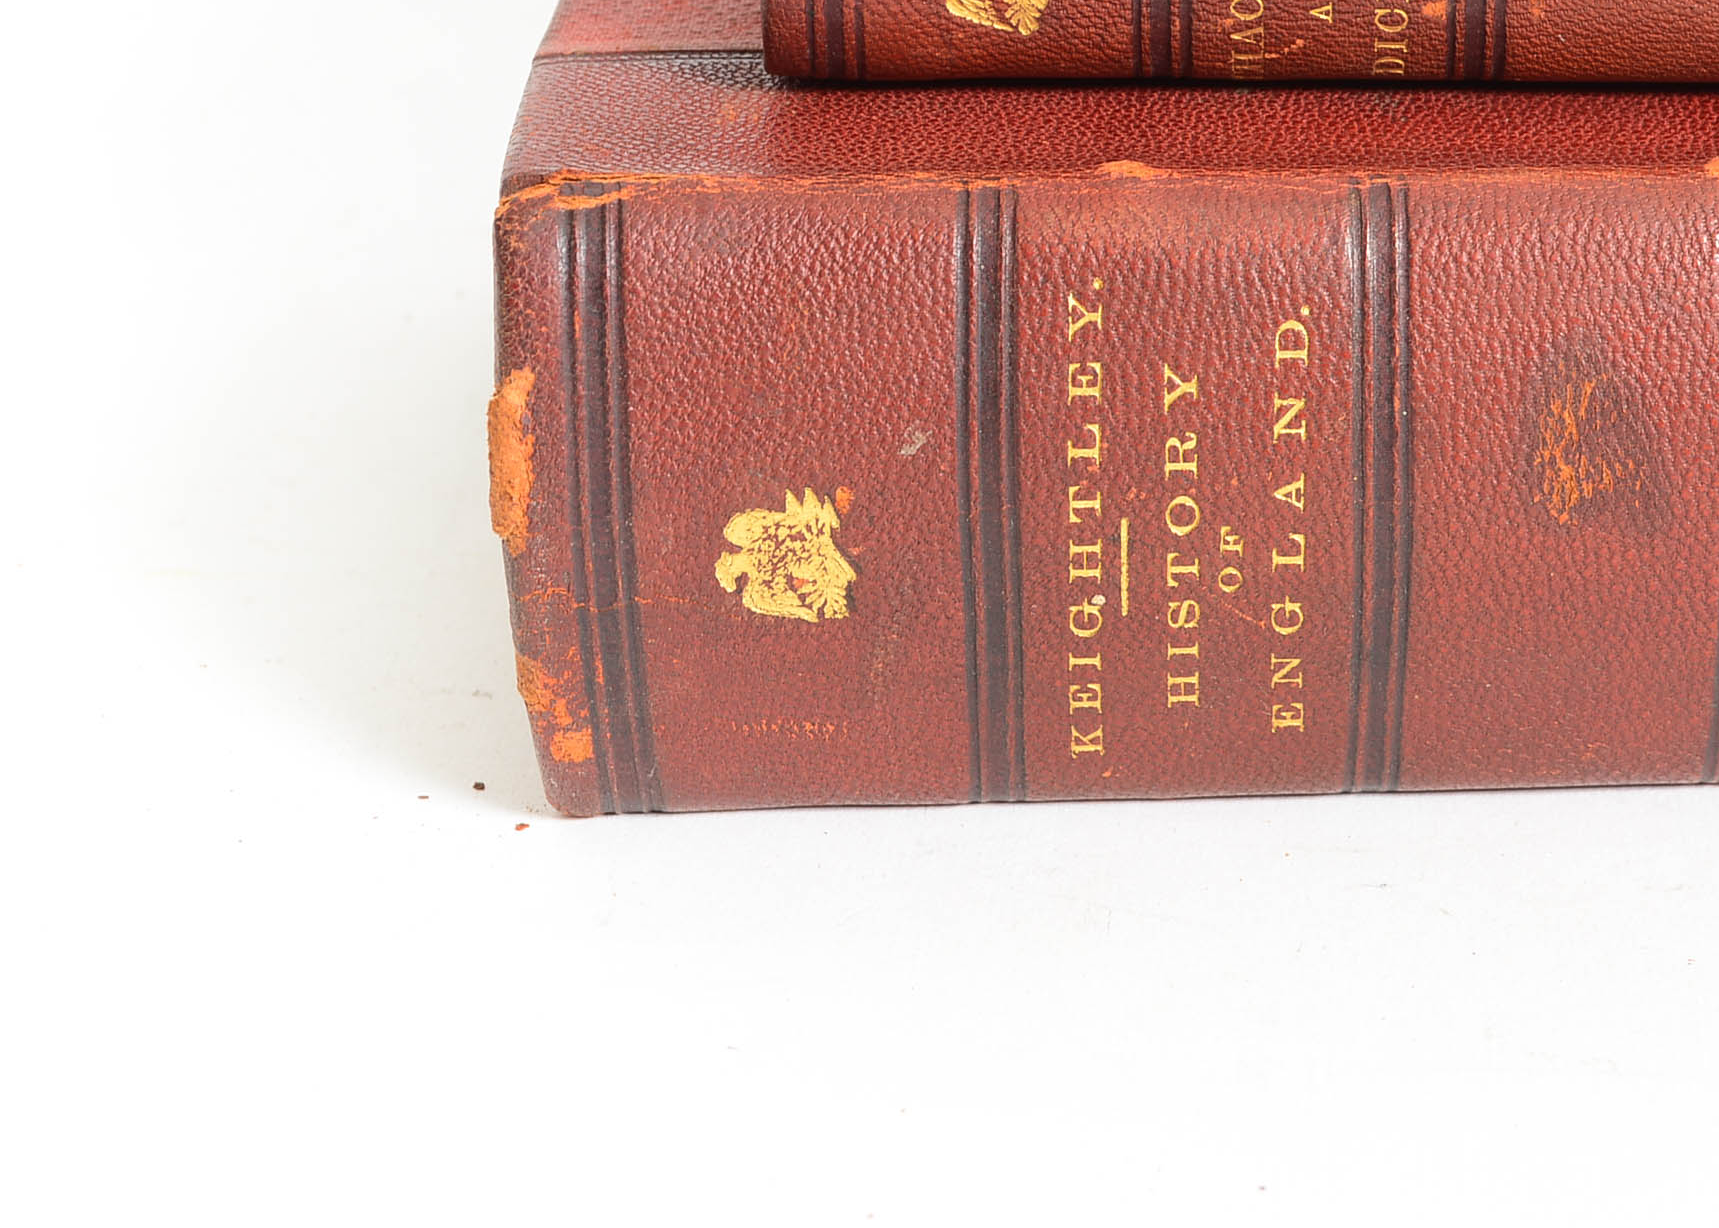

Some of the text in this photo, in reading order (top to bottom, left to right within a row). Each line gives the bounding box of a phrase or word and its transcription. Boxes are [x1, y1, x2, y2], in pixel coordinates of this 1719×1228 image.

[1067, 277, 1105, 759] KEIGHTLEY.
[1163, 364, 1201, 709] HISTORY
[1218, 525, 1244, 593] OF
[1270, 304, 1311, 734] ENGLAND.
